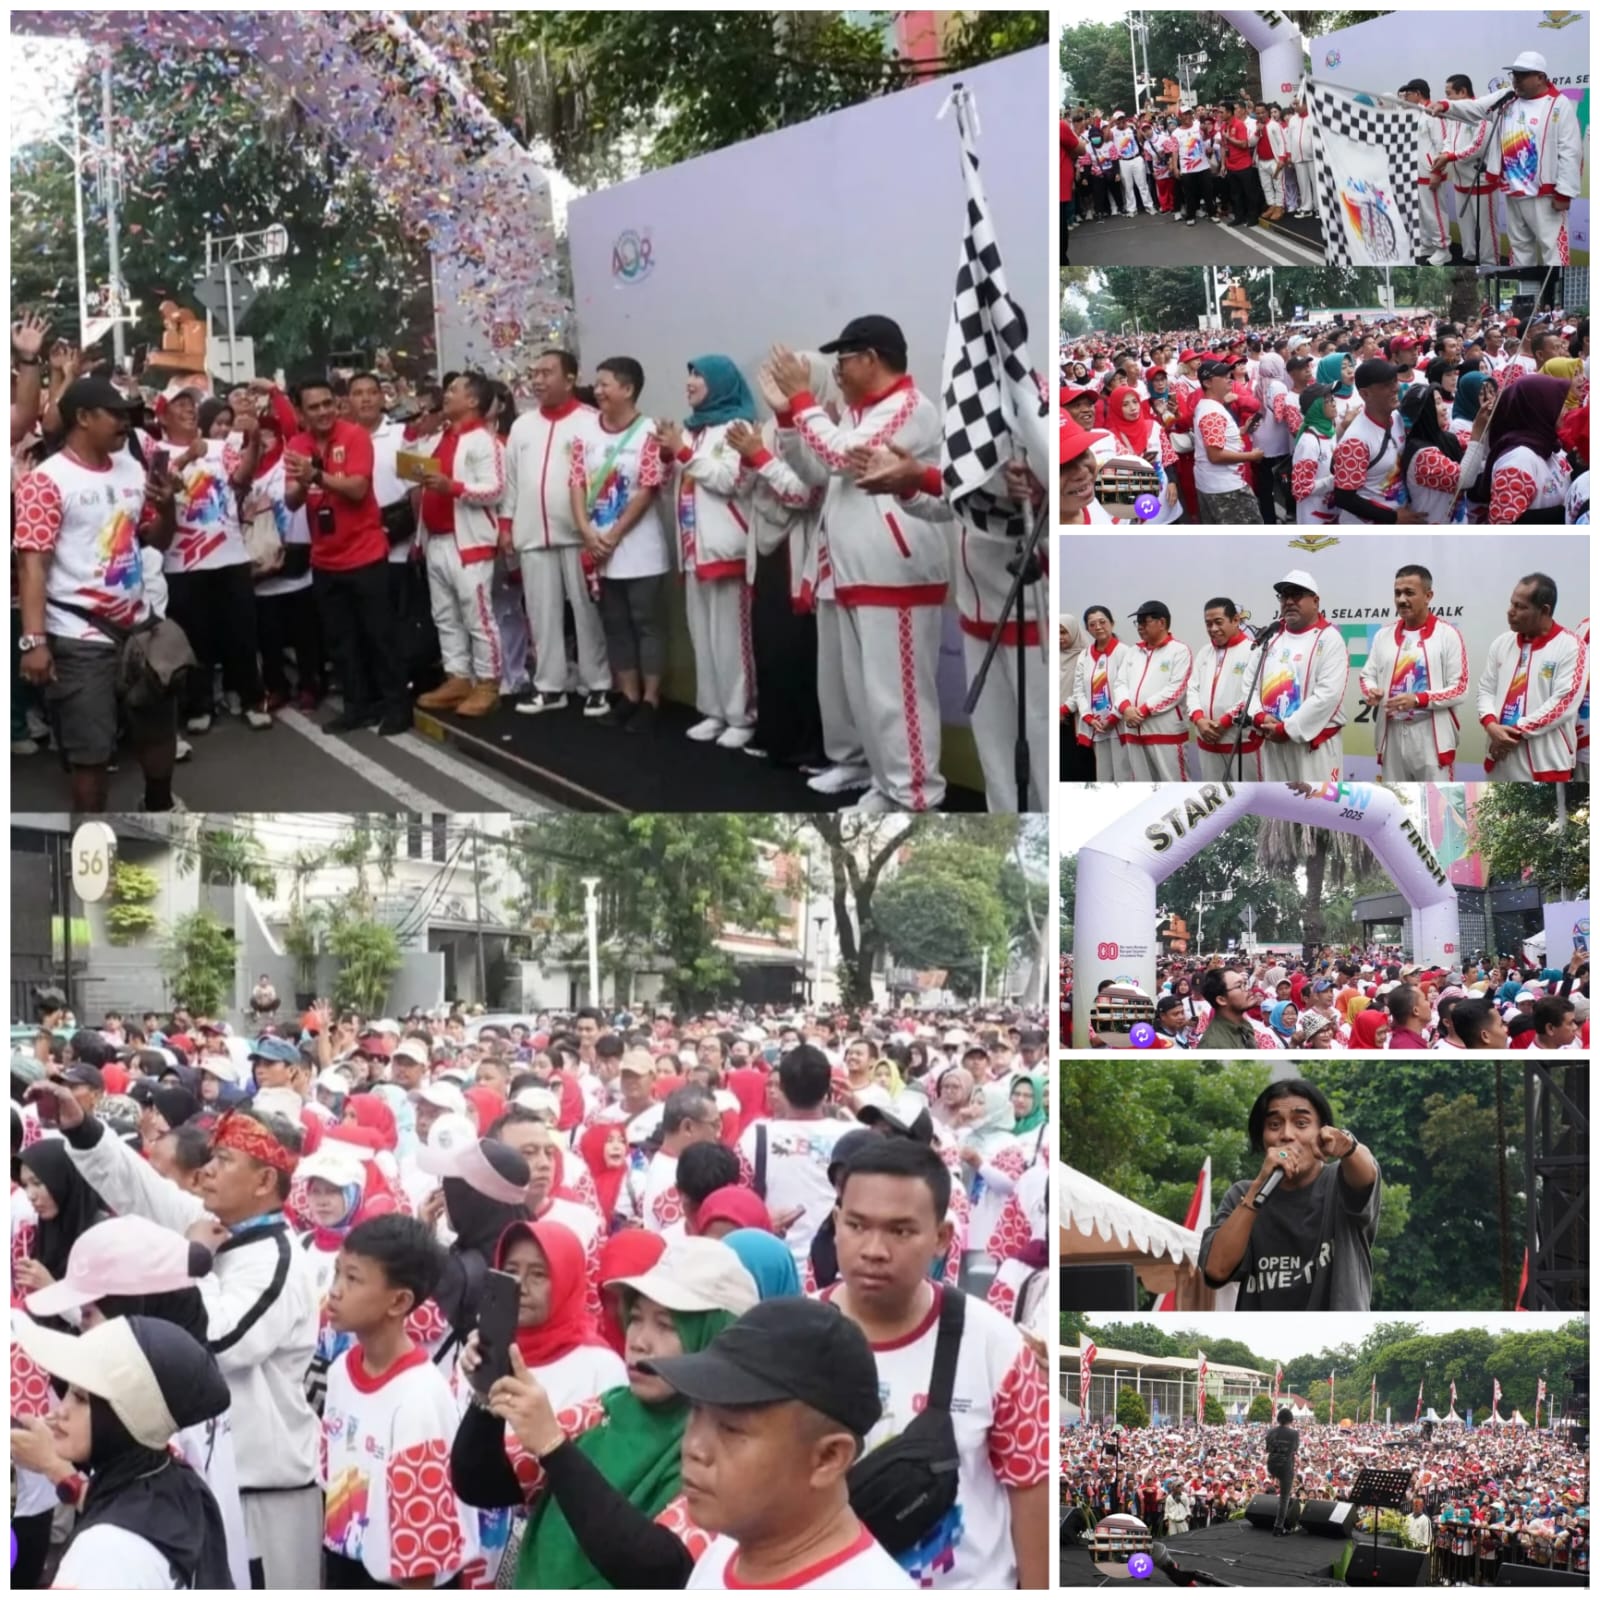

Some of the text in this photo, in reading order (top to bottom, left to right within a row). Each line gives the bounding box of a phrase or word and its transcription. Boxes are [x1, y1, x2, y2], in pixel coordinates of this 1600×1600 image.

[1331, 607, 1390, 619] SELATAN
[1339, 807, 1365, 821] 2025
[1400, 818, 1447, 887] FINISH
[78, 849, 103, 876] 56
[1258, 1255, 1301, 1271] OPEN
